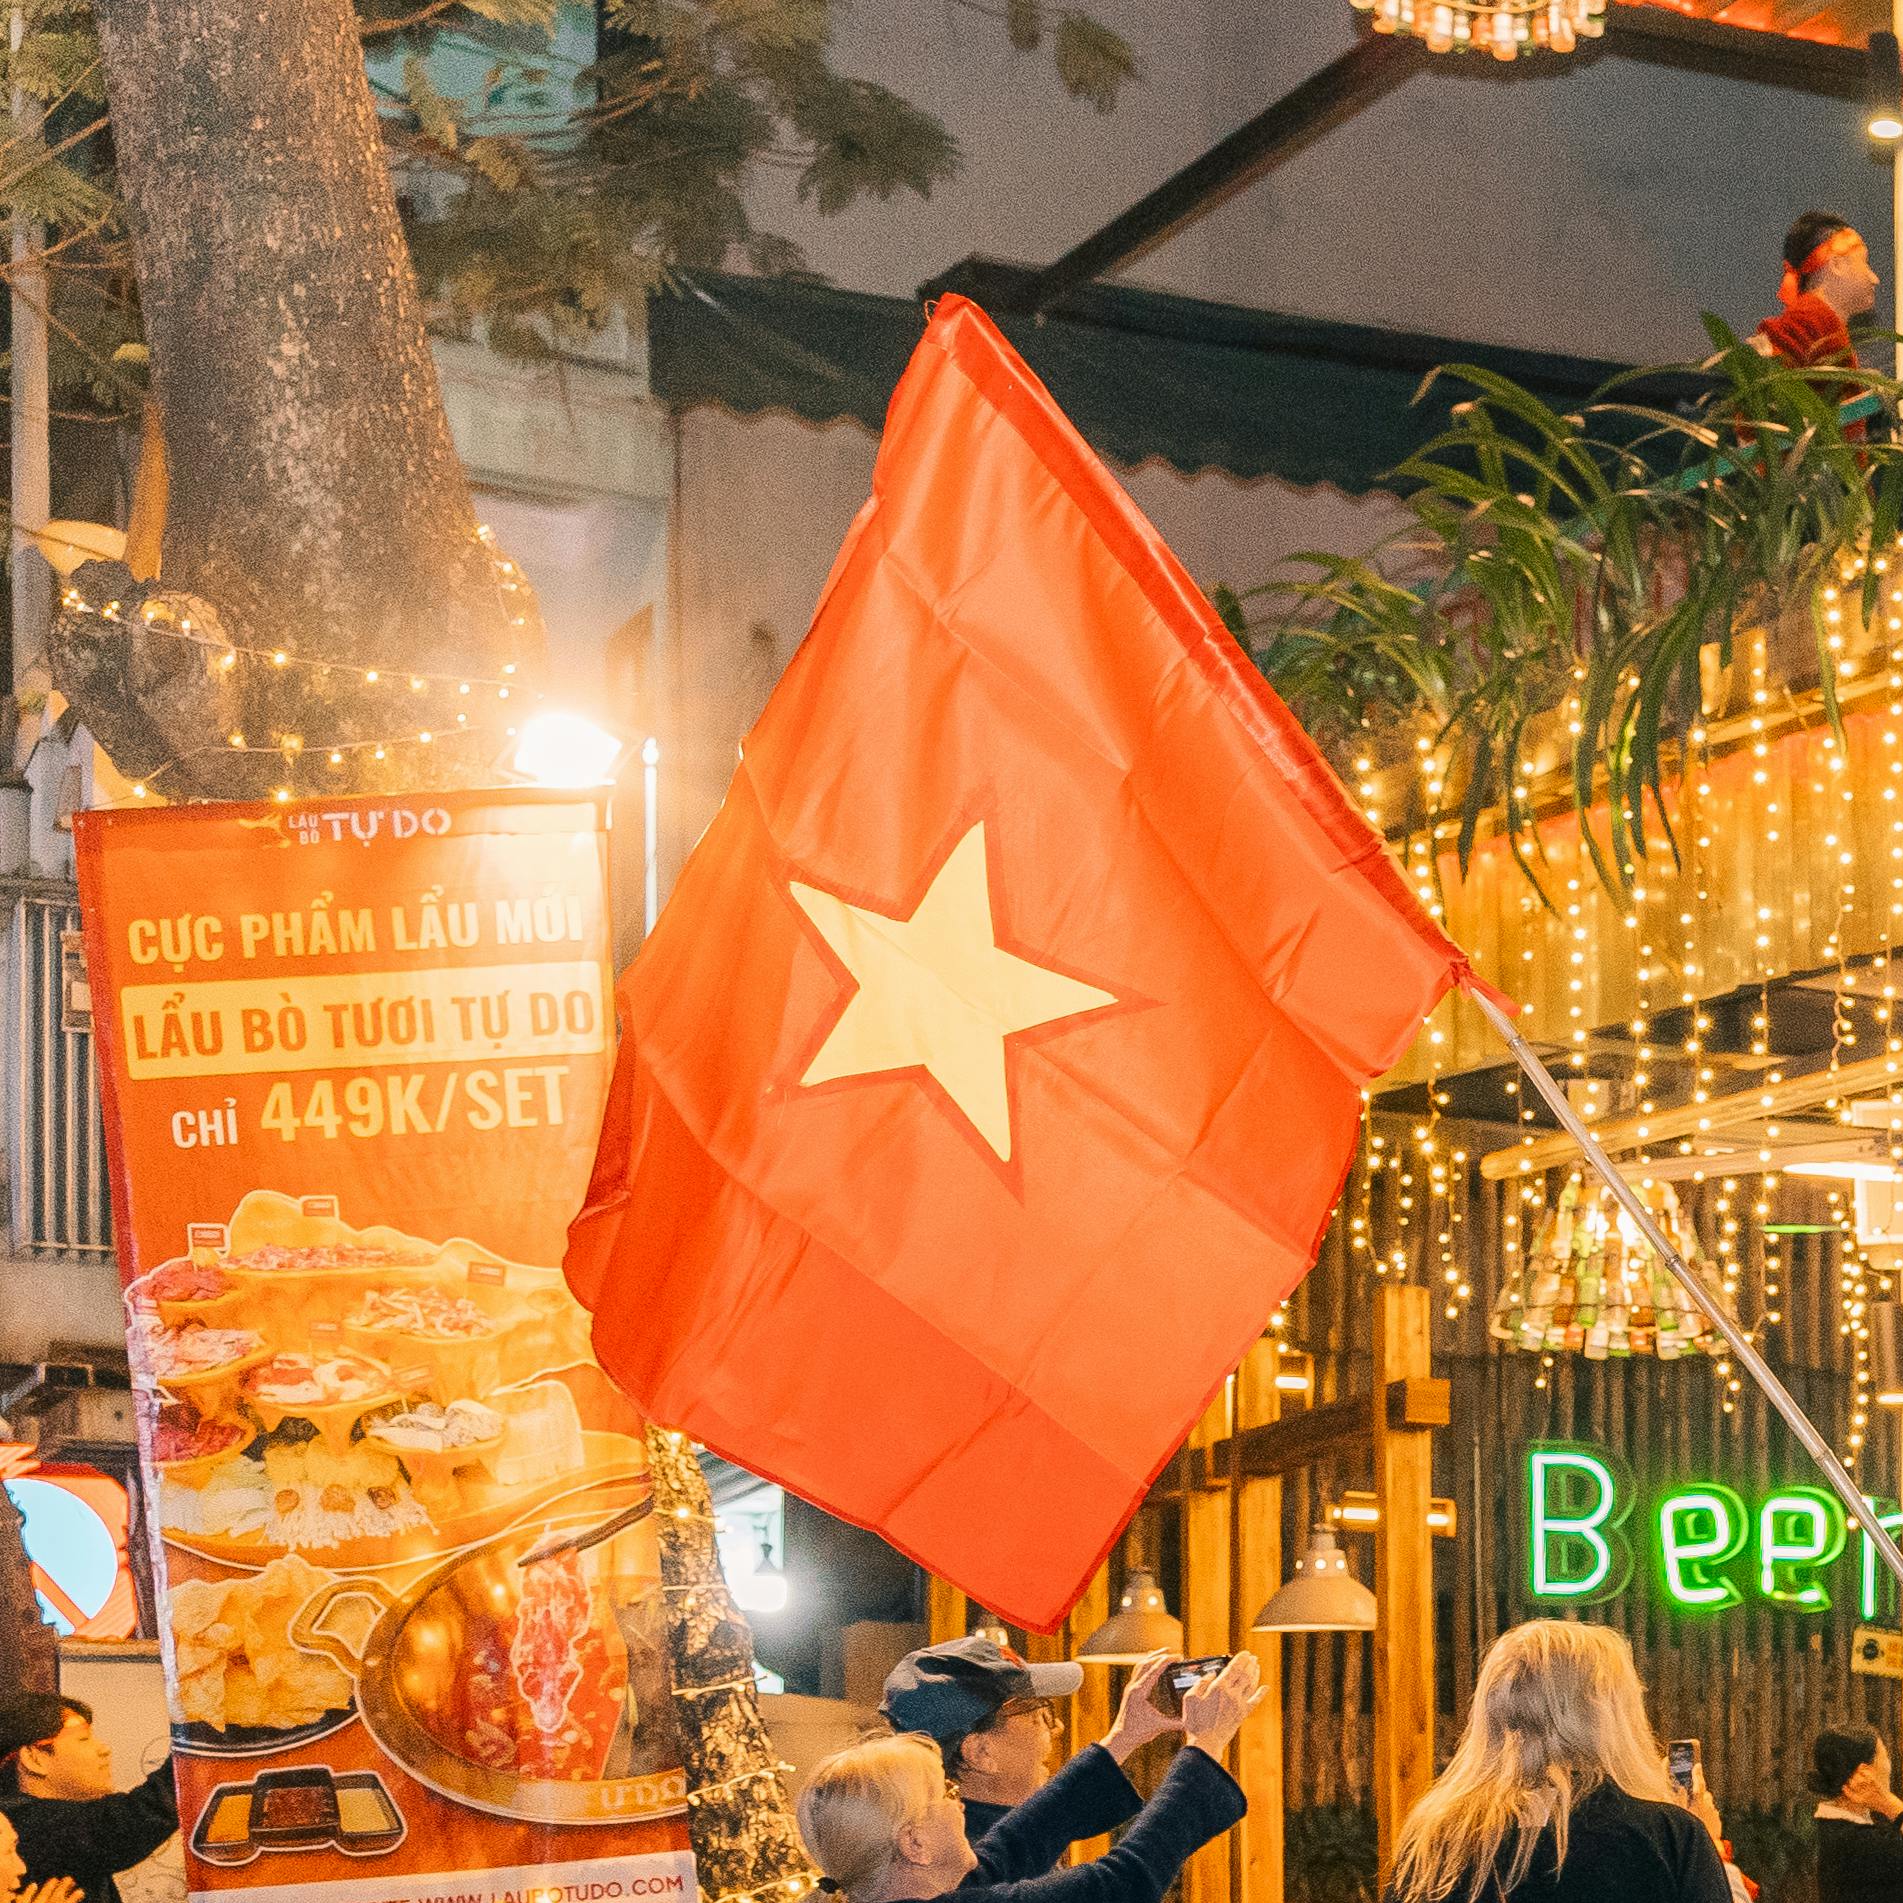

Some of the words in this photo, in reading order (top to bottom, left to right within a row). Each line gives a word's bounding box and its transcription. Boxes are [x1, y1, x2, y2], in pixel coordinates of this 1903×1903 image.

[392, 808, 452, 838] DO
[128, 913, 224, 973] CỰC
[242, 891, 376, 959] PHẨM
[391, 884, 479, 950] LẨU
[134, 993, 224, 1061] LẨU
[242, 992, 307, 1053] BÒ
[324, 995, 435, 1046] TƯƠI
[451, 990, 511, 1049] TỰ
[529, 990, 594, 1036] DO
[171, 1098, 238, 1150] CHỈ
[259, 1065, 569, 1141] 449K/SET
